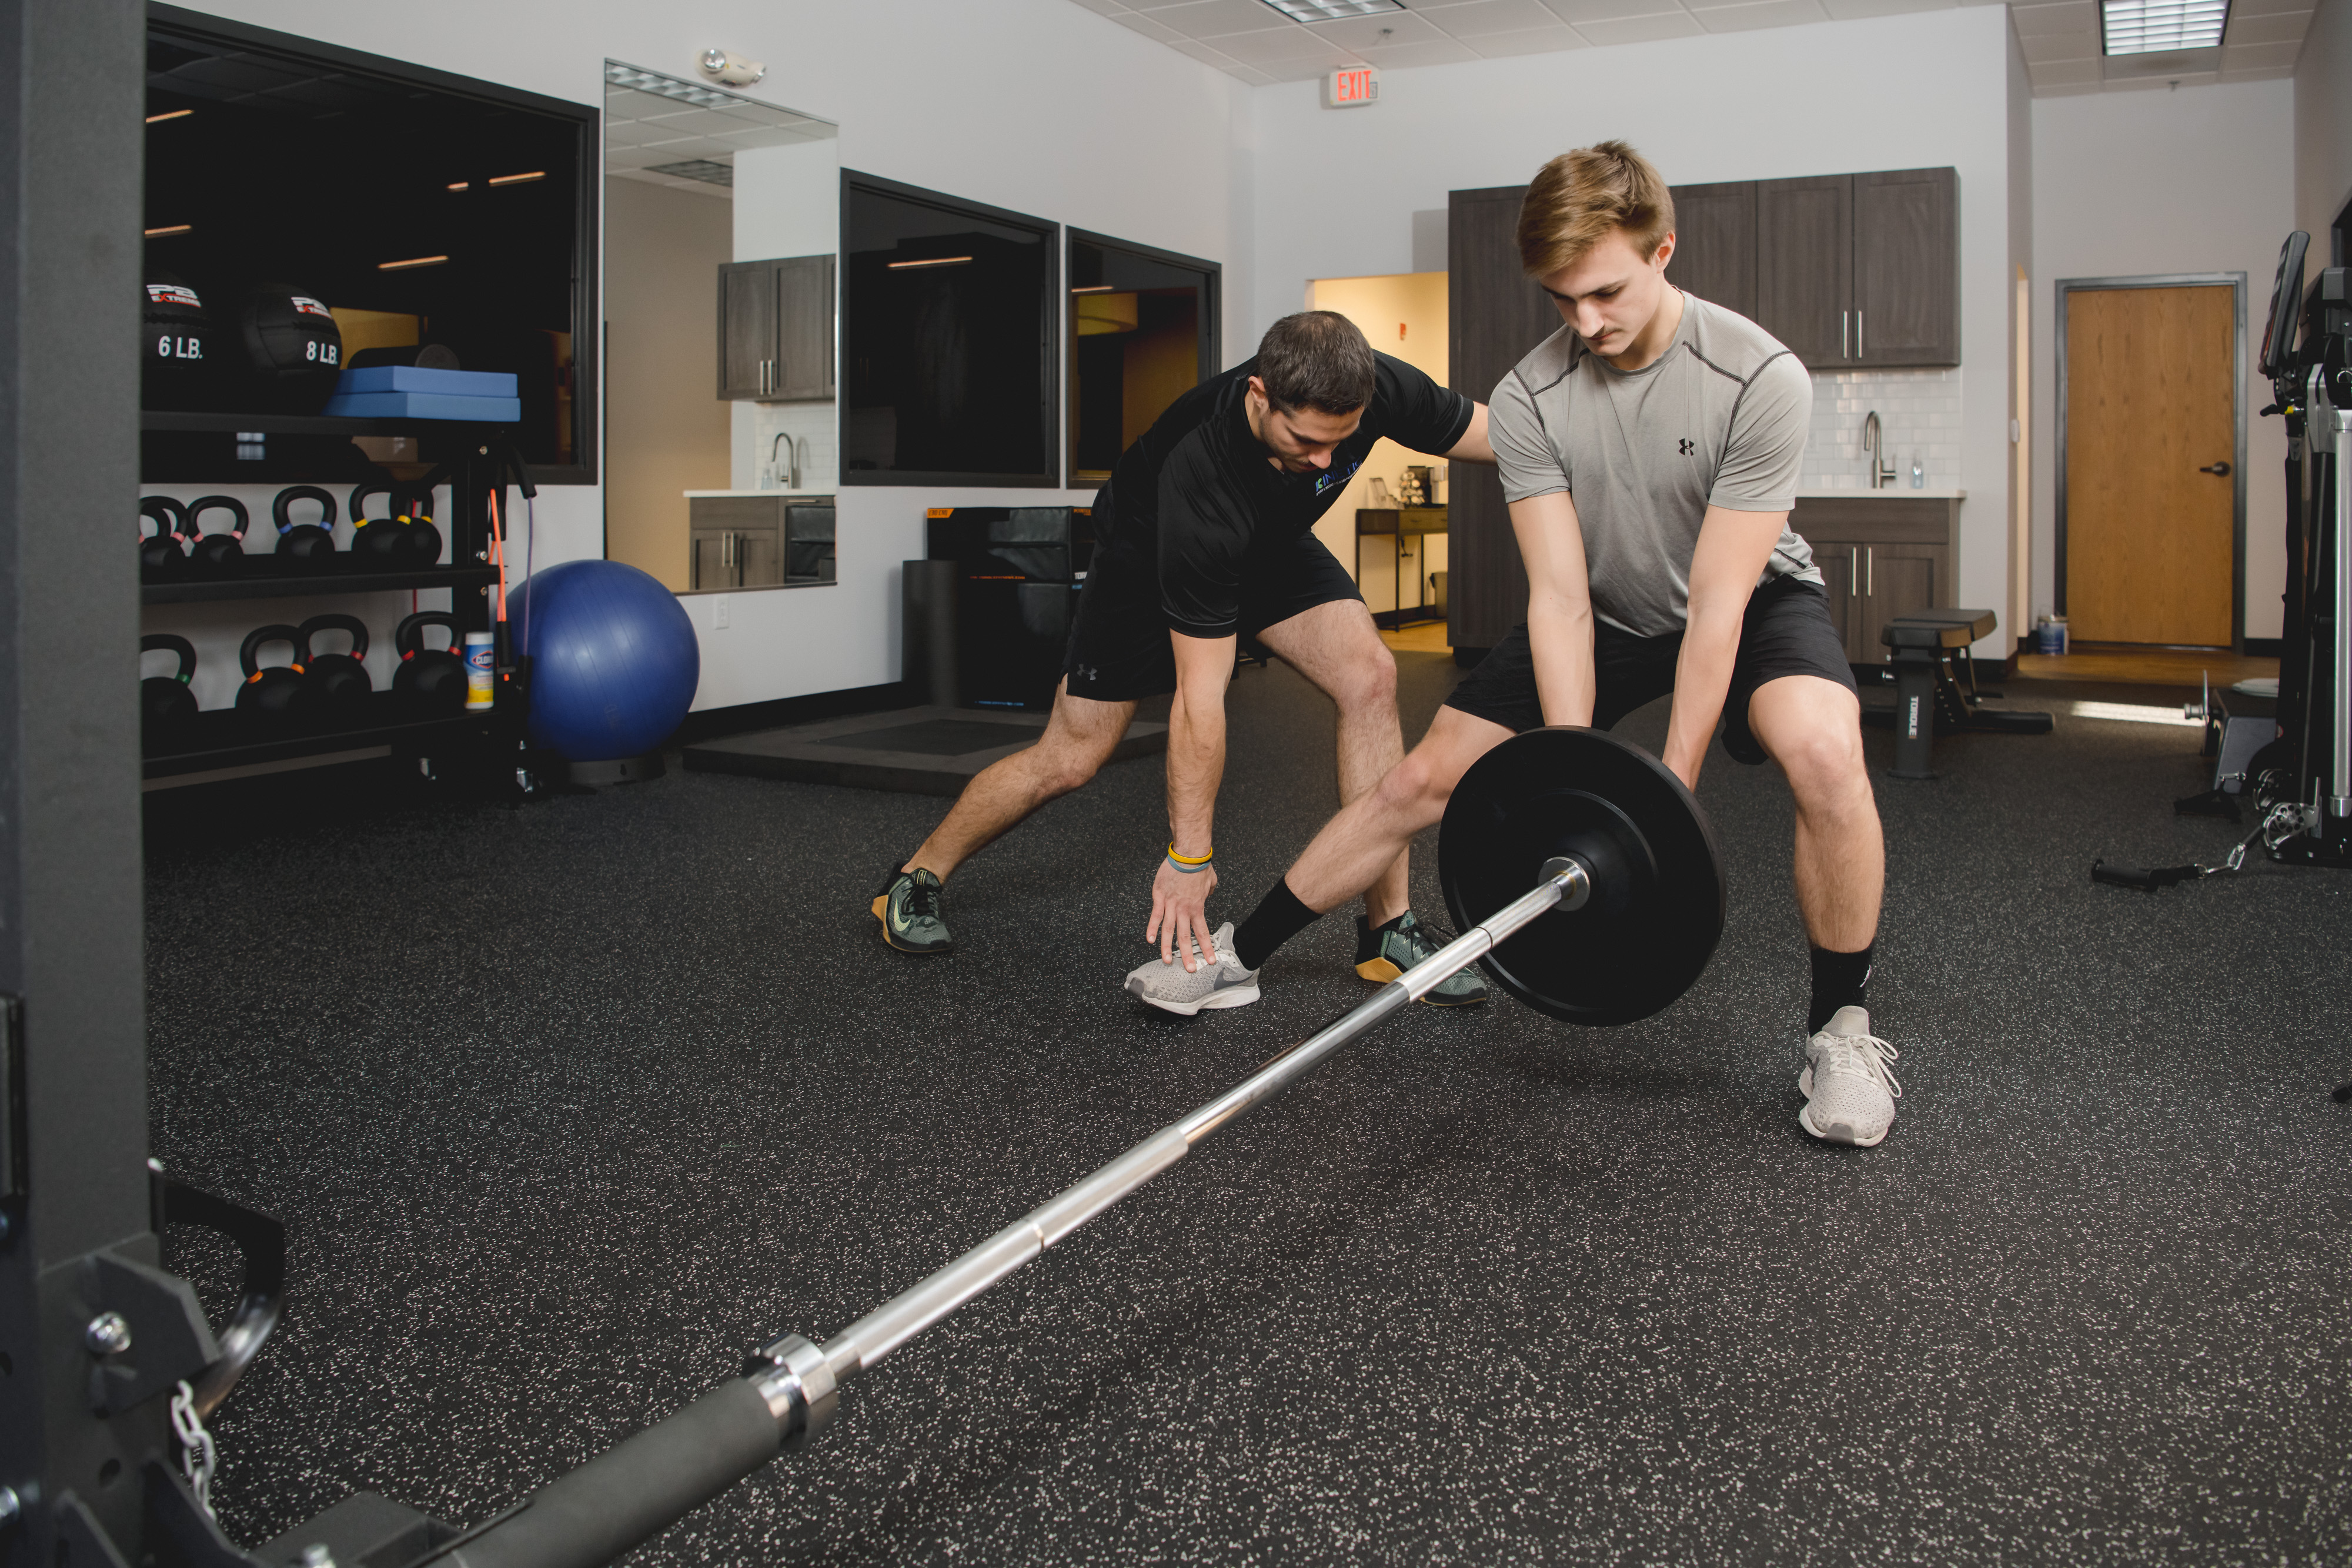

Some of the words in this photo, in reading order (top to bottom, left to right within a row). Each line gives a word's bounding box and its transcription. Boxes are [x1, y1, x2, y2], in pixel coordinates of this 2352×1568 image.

[1338, 70, 1371, 101] EXIT
[159, 335, 171, 357] 6
[176, 337, 203, 359] LB.
[306, 341, 317, 361] 8
[1909, 696, 1919, 735] TORQUE
